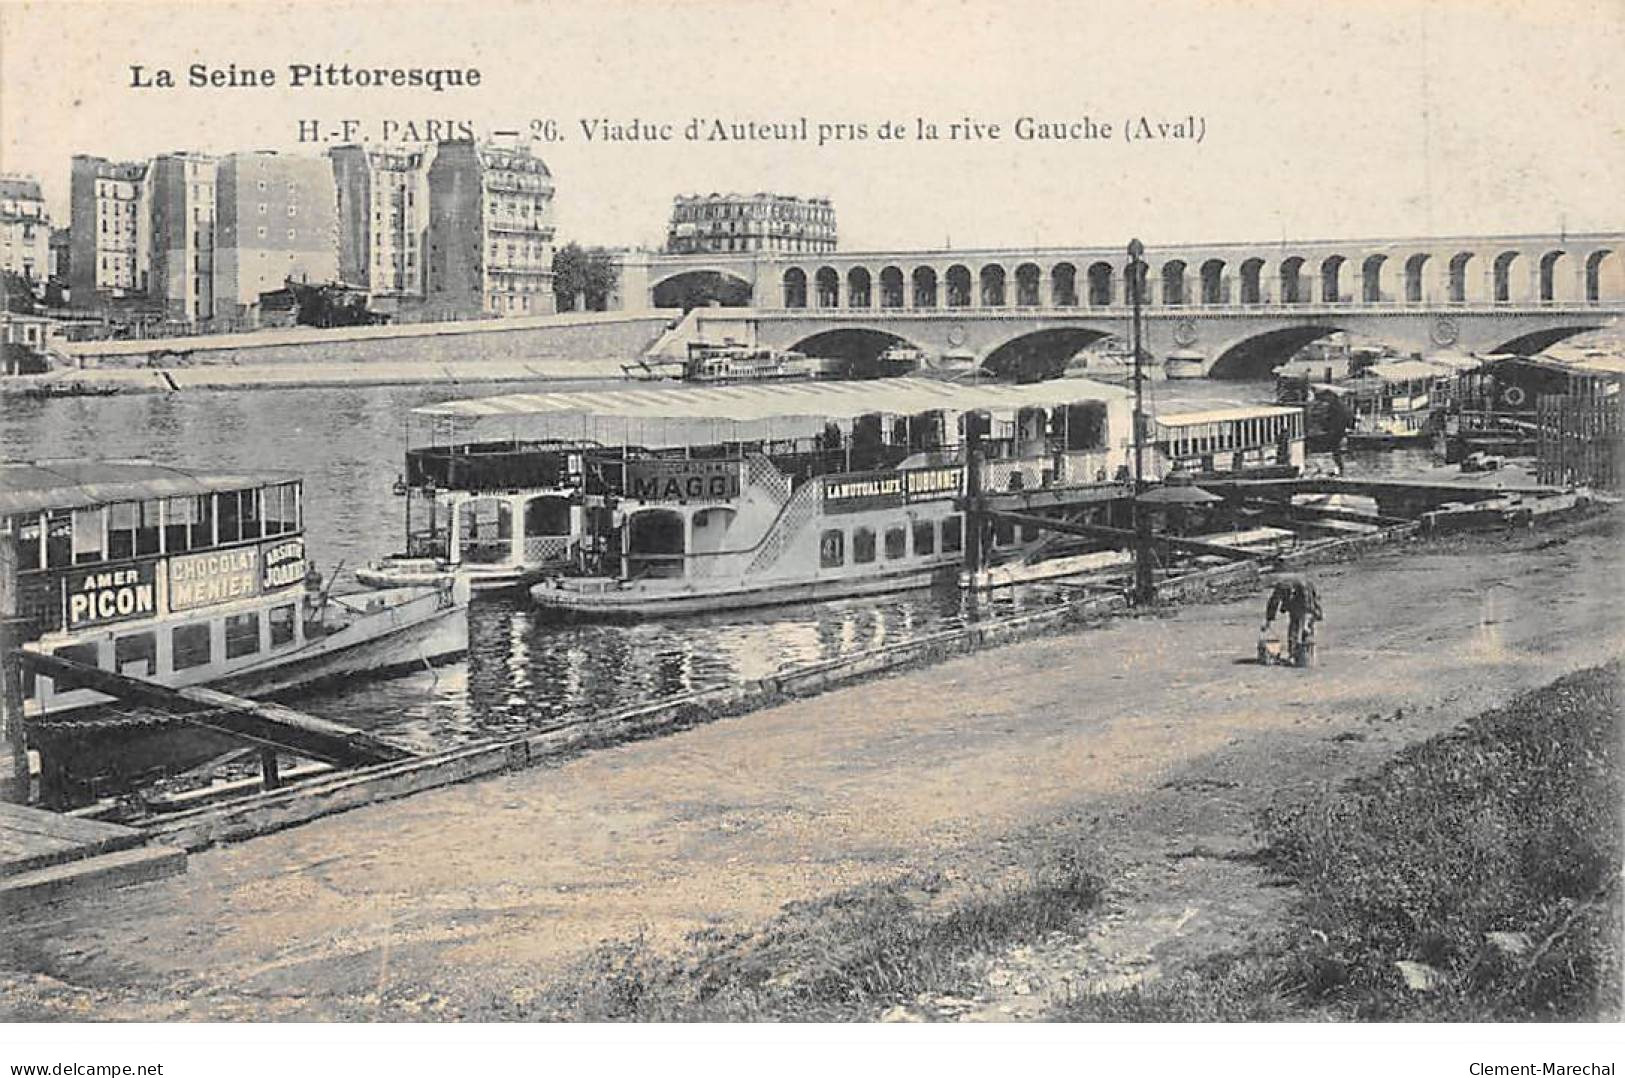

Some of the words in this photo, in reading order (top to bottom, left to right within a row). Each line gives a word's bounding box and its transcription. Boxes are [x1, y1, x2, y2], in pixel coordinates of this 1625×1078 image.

[633, 475, 739, 498] MAGGI
[172, 550, 257, 580] CHOCOLAT
[84, 570, 138, 590] AMER
[174, 575, 255, 604] MENIER
[71, 583, 152, 623] PICON
